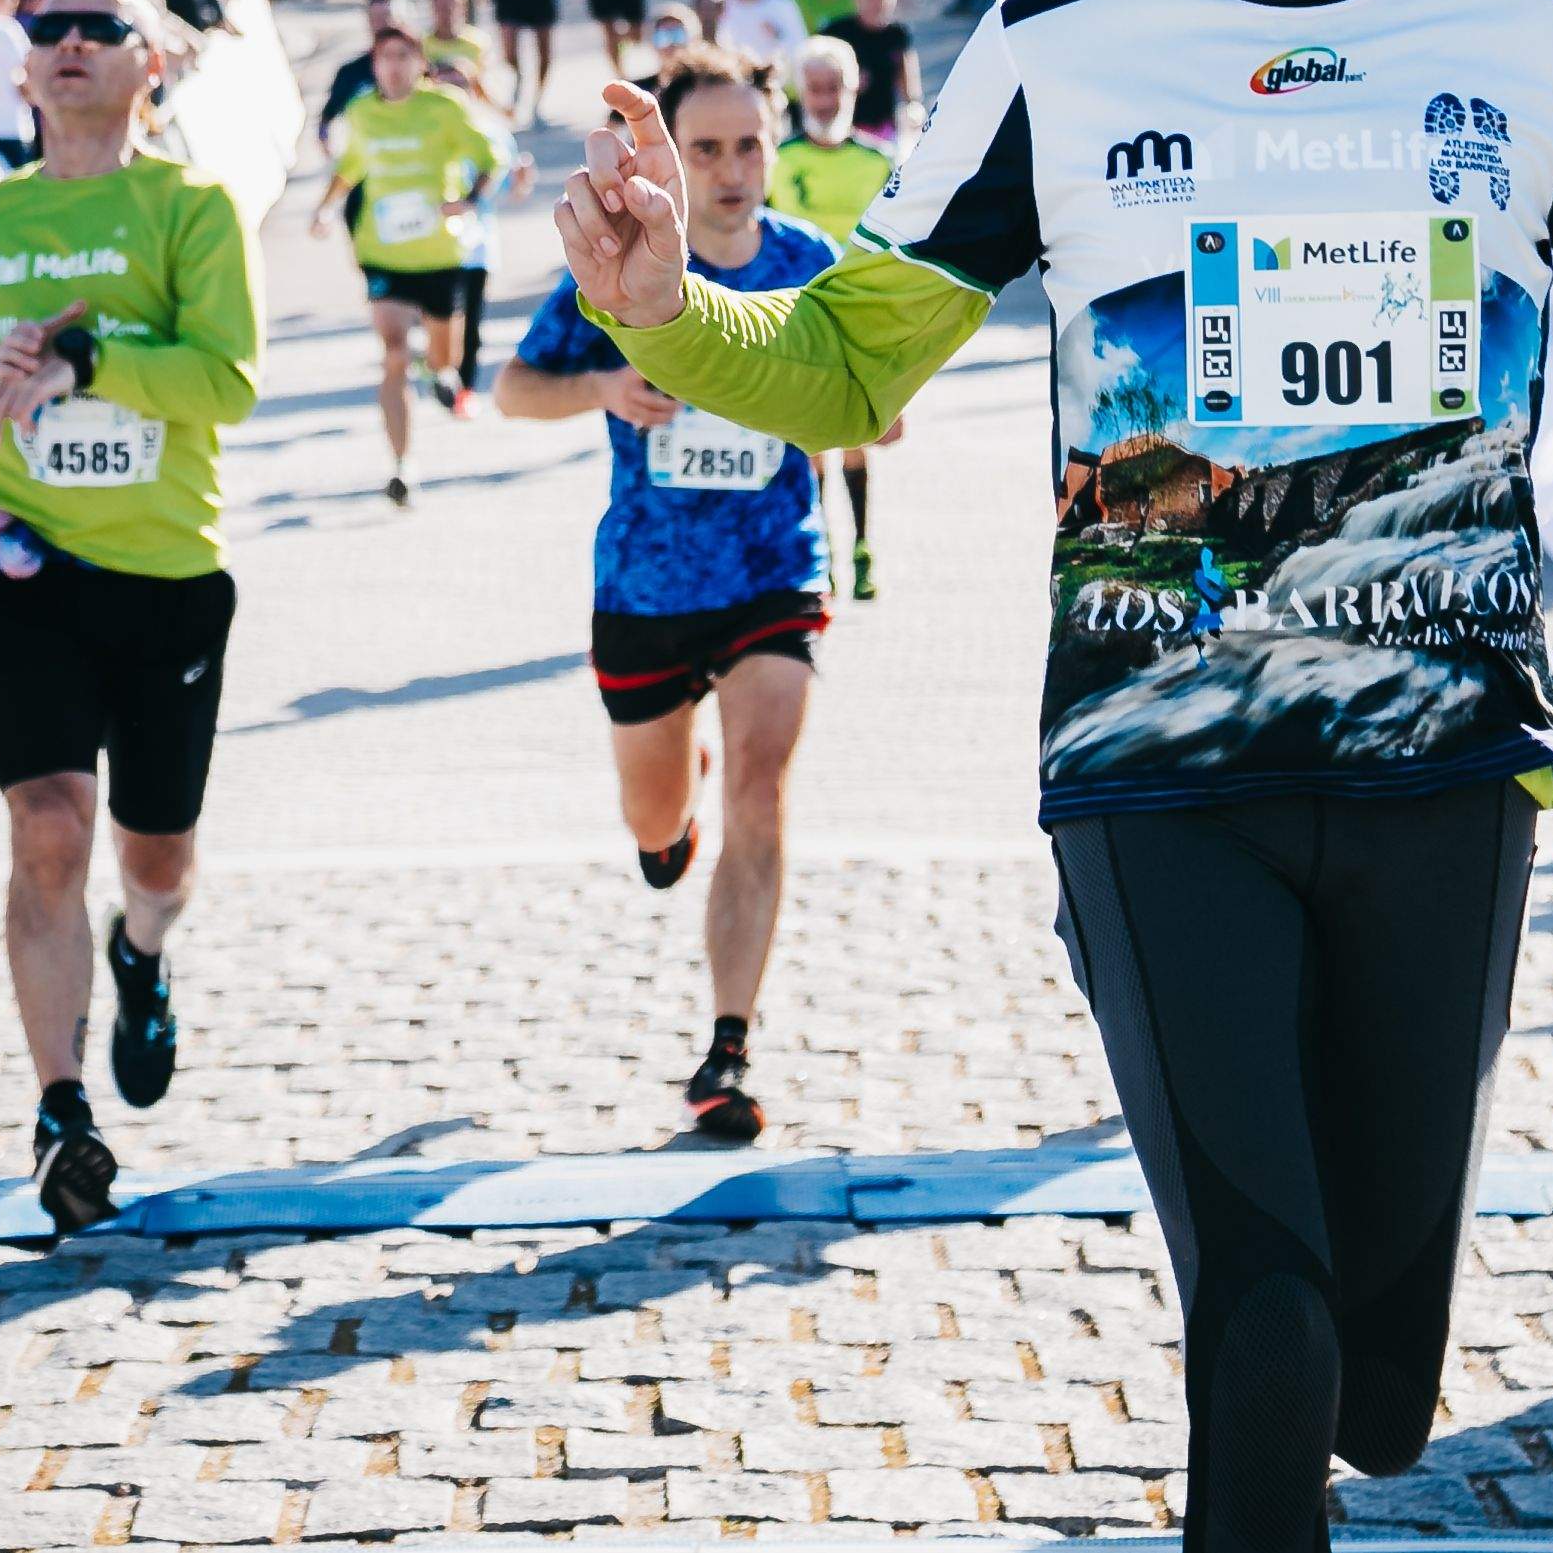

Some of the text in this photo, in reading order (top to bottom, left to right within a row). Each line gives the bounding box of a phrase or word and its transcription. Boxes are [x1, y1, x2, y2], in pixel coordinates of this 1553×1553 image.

[1267, 58, 1347, 93] global
[1441, 149, 1503, 165] MALPARTIDA
[1443, 138, 1499, 154] ATLETISMO
[1431, 158, 1452, 168] LOS
[1110, 175, 1195, 194] MALPARTIDA
[32, 247, 129, 280] MetLife
[1302, 240, 1417, 265] MetLife
[1253, 287, 1281, 304] VIII
[1281, 340, 1393, 406] 901
[48, 441, 131, 475] 4585
[681, 447, 755, 479] 2850
[1087, 588, 1186, 632] LOS
